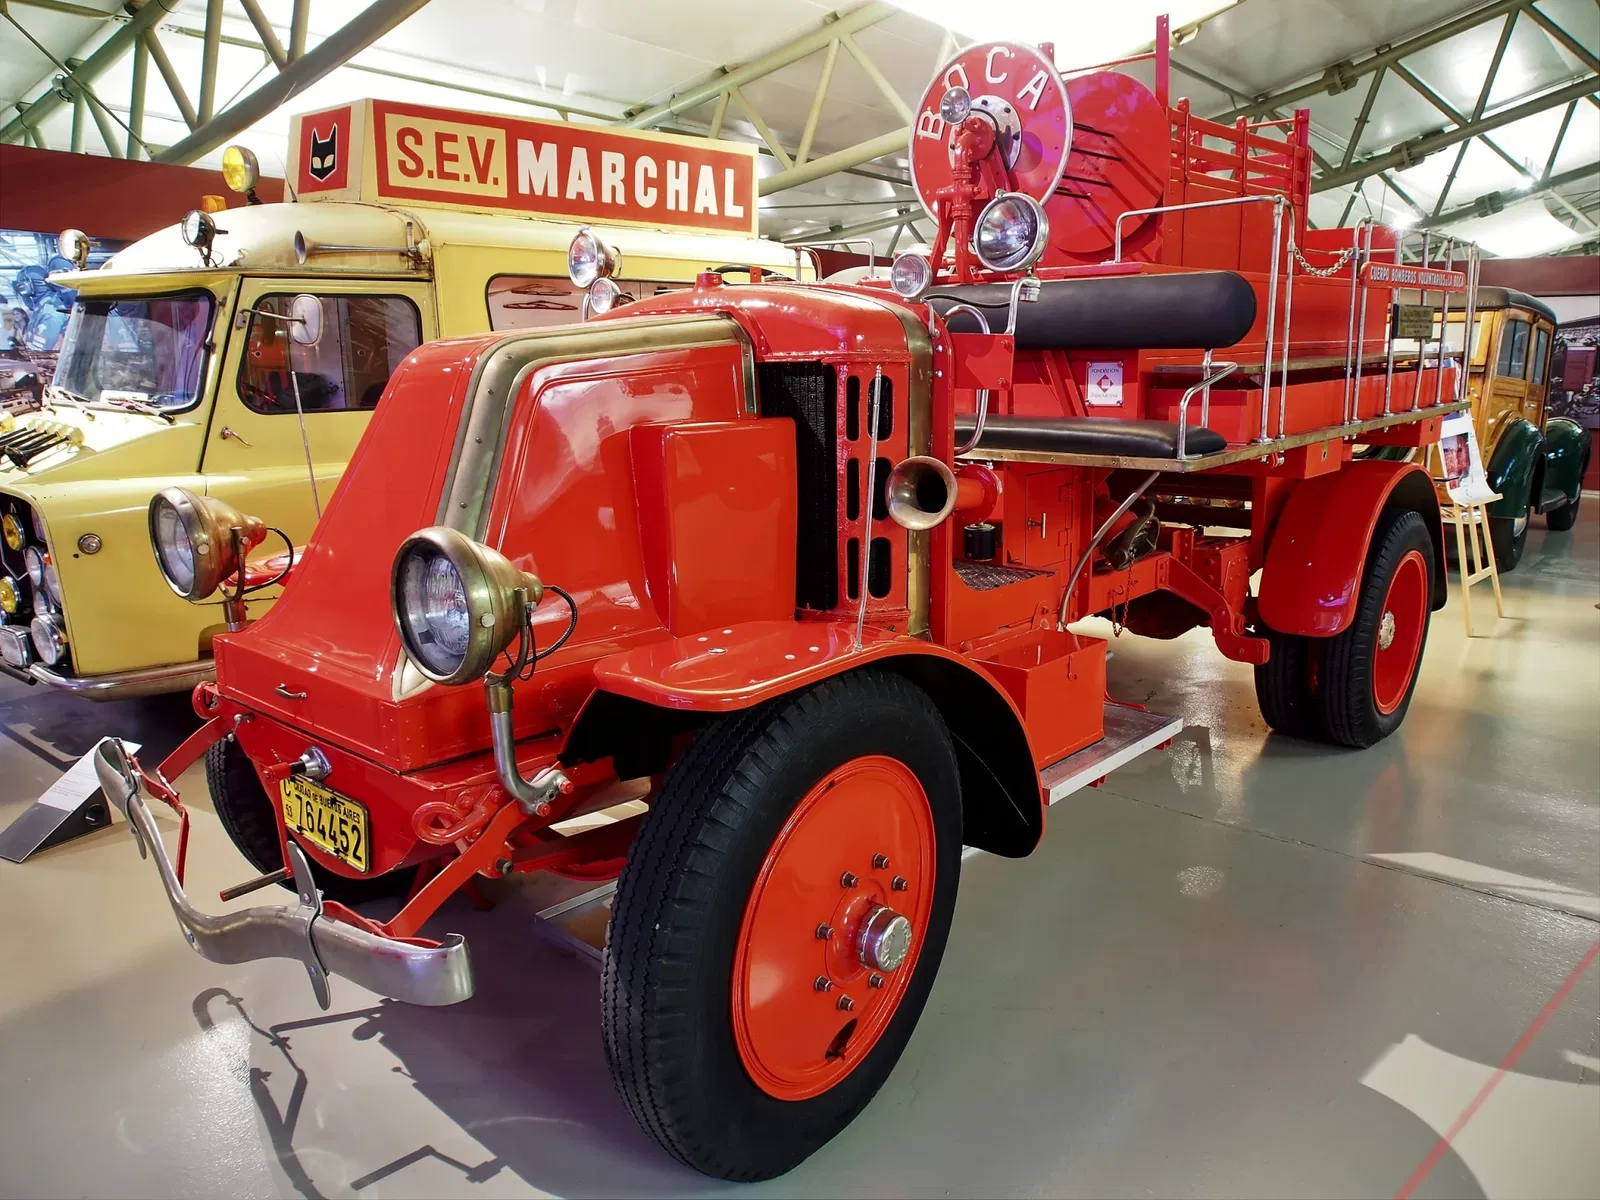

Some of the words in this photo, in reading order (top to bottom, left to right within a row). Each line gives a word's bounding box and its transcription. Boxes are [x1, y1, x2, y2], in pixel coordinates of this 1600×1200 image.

[917, 46, 1049, 141] BOCA
[396, 126, 500, 186] S.E.V.
[517, 139, 744, 219] MARCHAL
[1371, 266, 1389, 281] CUERPO
[1392, 269, 1416, 284] BOMBEROS
[343, 806, 361, 824] AIRES
